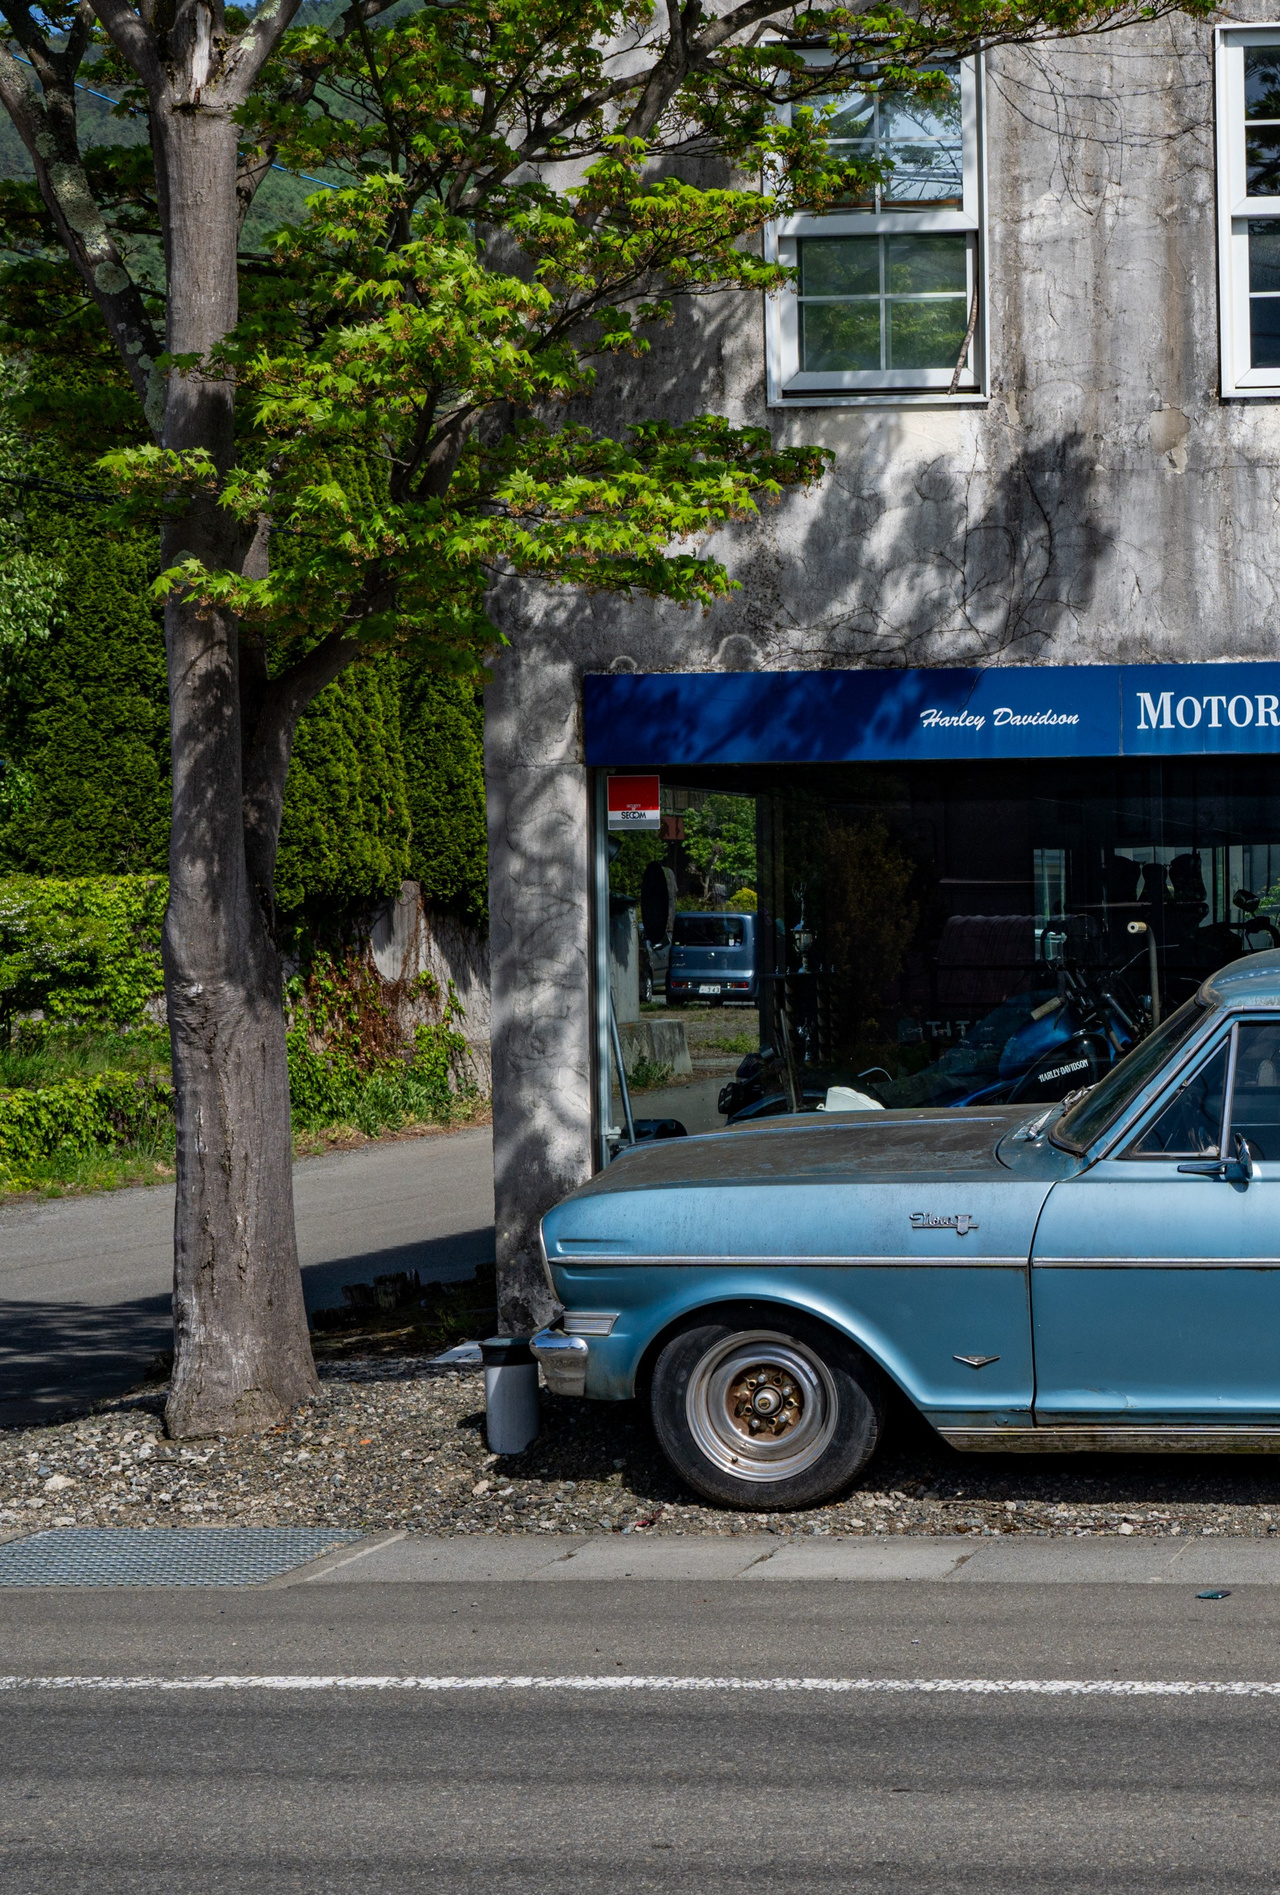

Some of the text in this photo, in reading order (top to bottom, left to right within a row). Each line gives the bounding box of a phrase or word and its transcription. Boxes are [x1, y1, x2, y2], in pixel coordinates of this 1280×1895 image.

[919, 707, 1080, 731] Harley Davidson
[621, 811, 647, 820] SECOM
[1037, 1059, 1089, 1083] HARLEY-DAVIDSON
